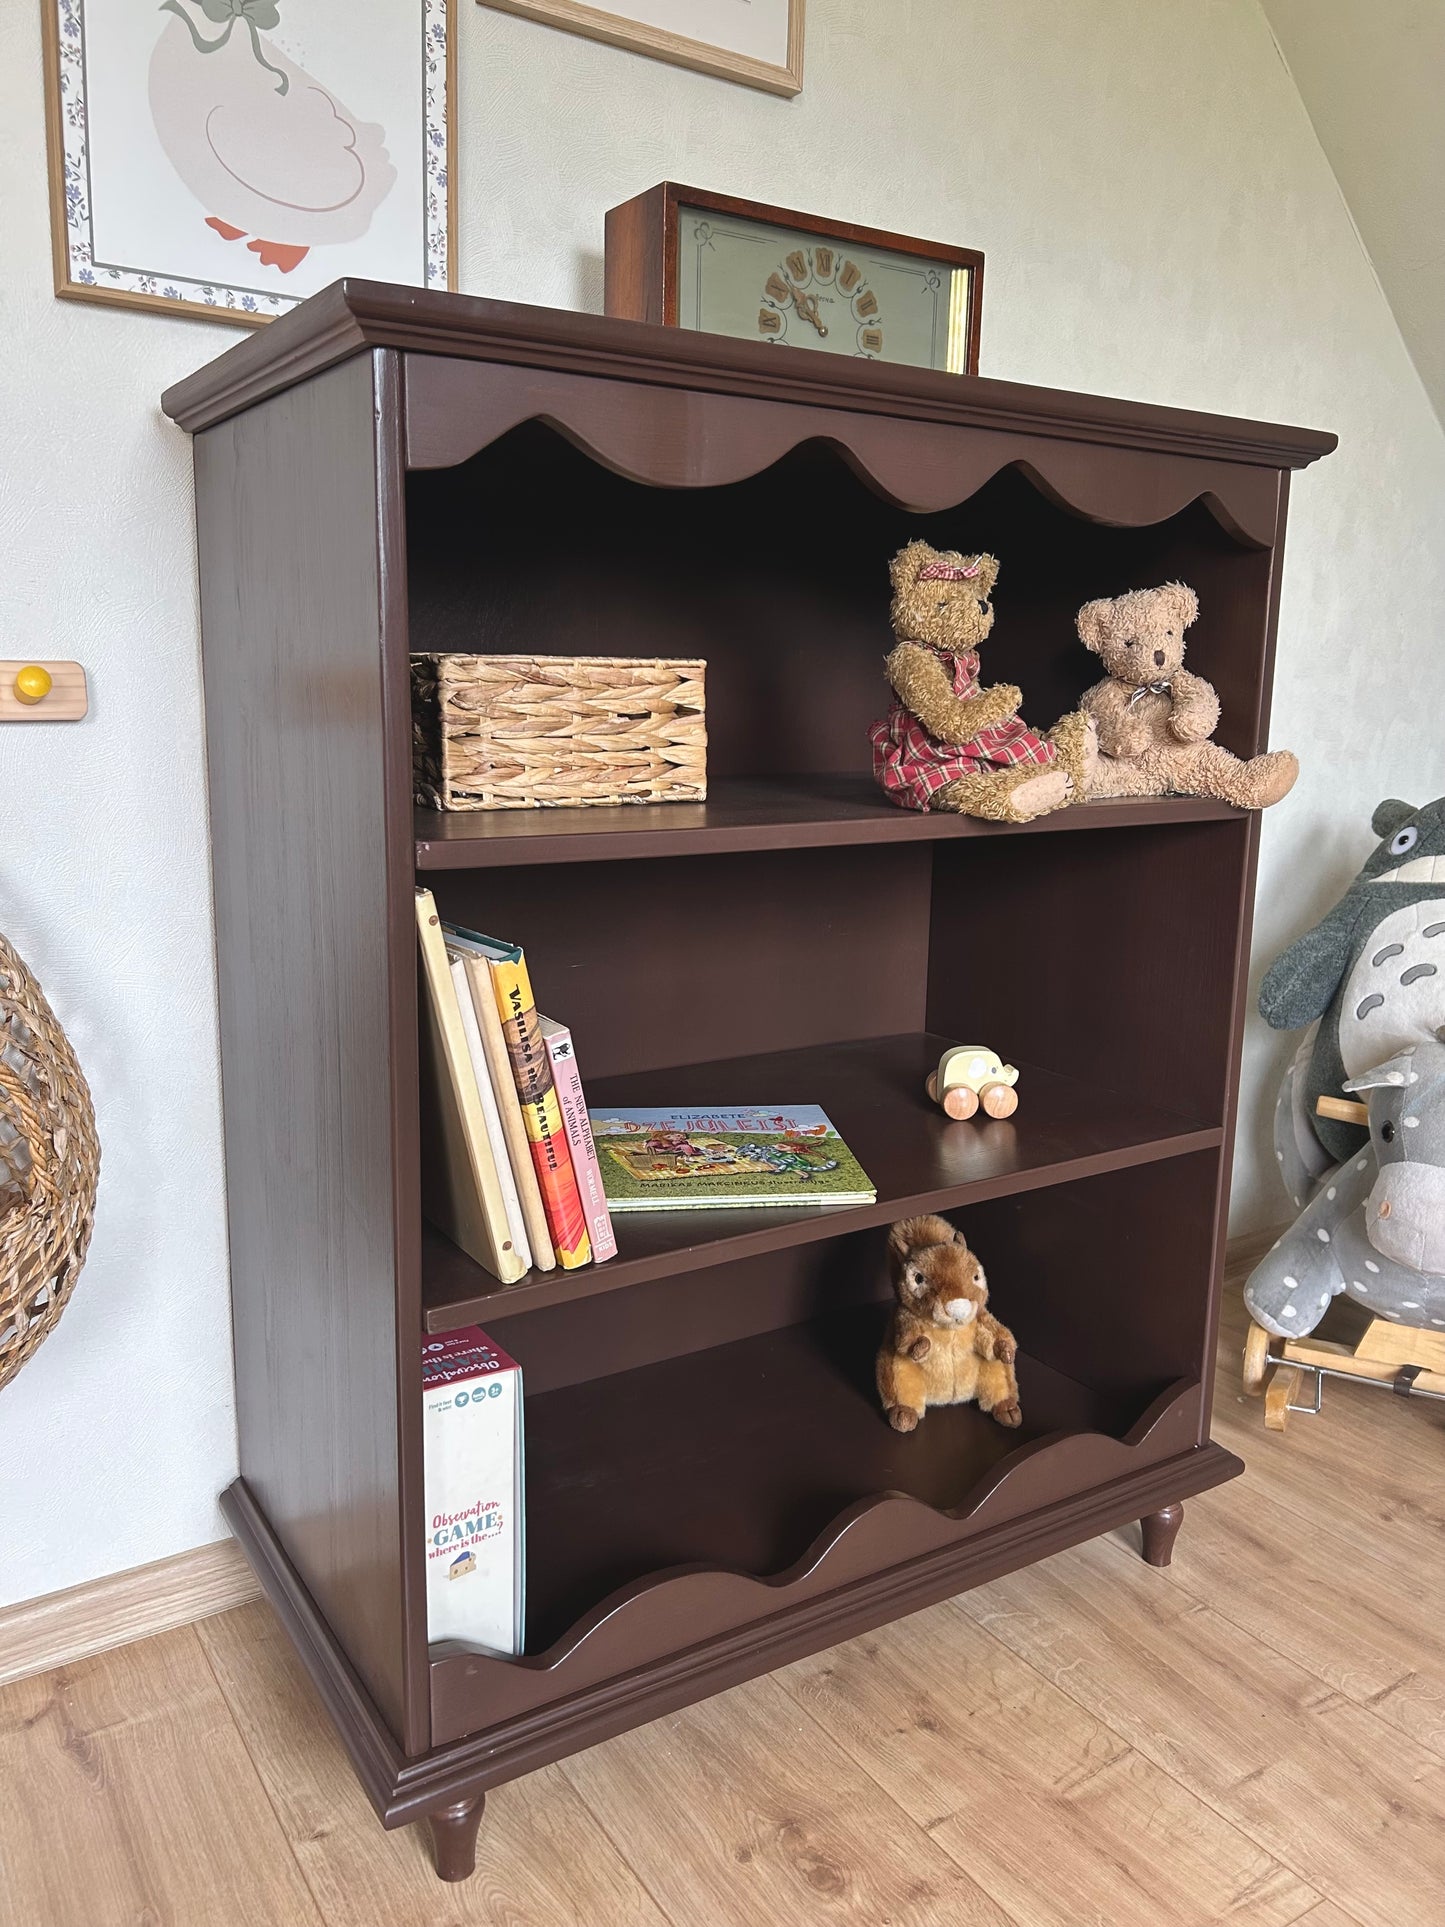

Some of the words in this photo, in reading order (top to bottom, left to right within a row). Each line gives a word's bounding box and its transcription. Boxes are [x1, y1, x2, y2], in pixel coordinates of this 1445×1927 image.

[509, 984, 534, 1063] VASILISA
[527, 1067, 538, 1091] the
[533, 1093, 558, 1172] BEAUTIFUL
[570, 1072, 581, 1093] THE
[562, 1096, 570, 1106] of
[574, 1094, 586, 1115] NEW
[565, 1107, 582, 1147] ANIMALS
[671, 1113, 746, 1121] ELIZABETE
[579, 1117, 597, 1161] ALPHABET
[586, 1169, 600, 1206] WORMELL
[432, 1500, 501, 1529] Observation
[433, 1511, 498, 1546] GAME
[428, 1543, 460, 1559] where
[460, 1538, 470, 1548] is
